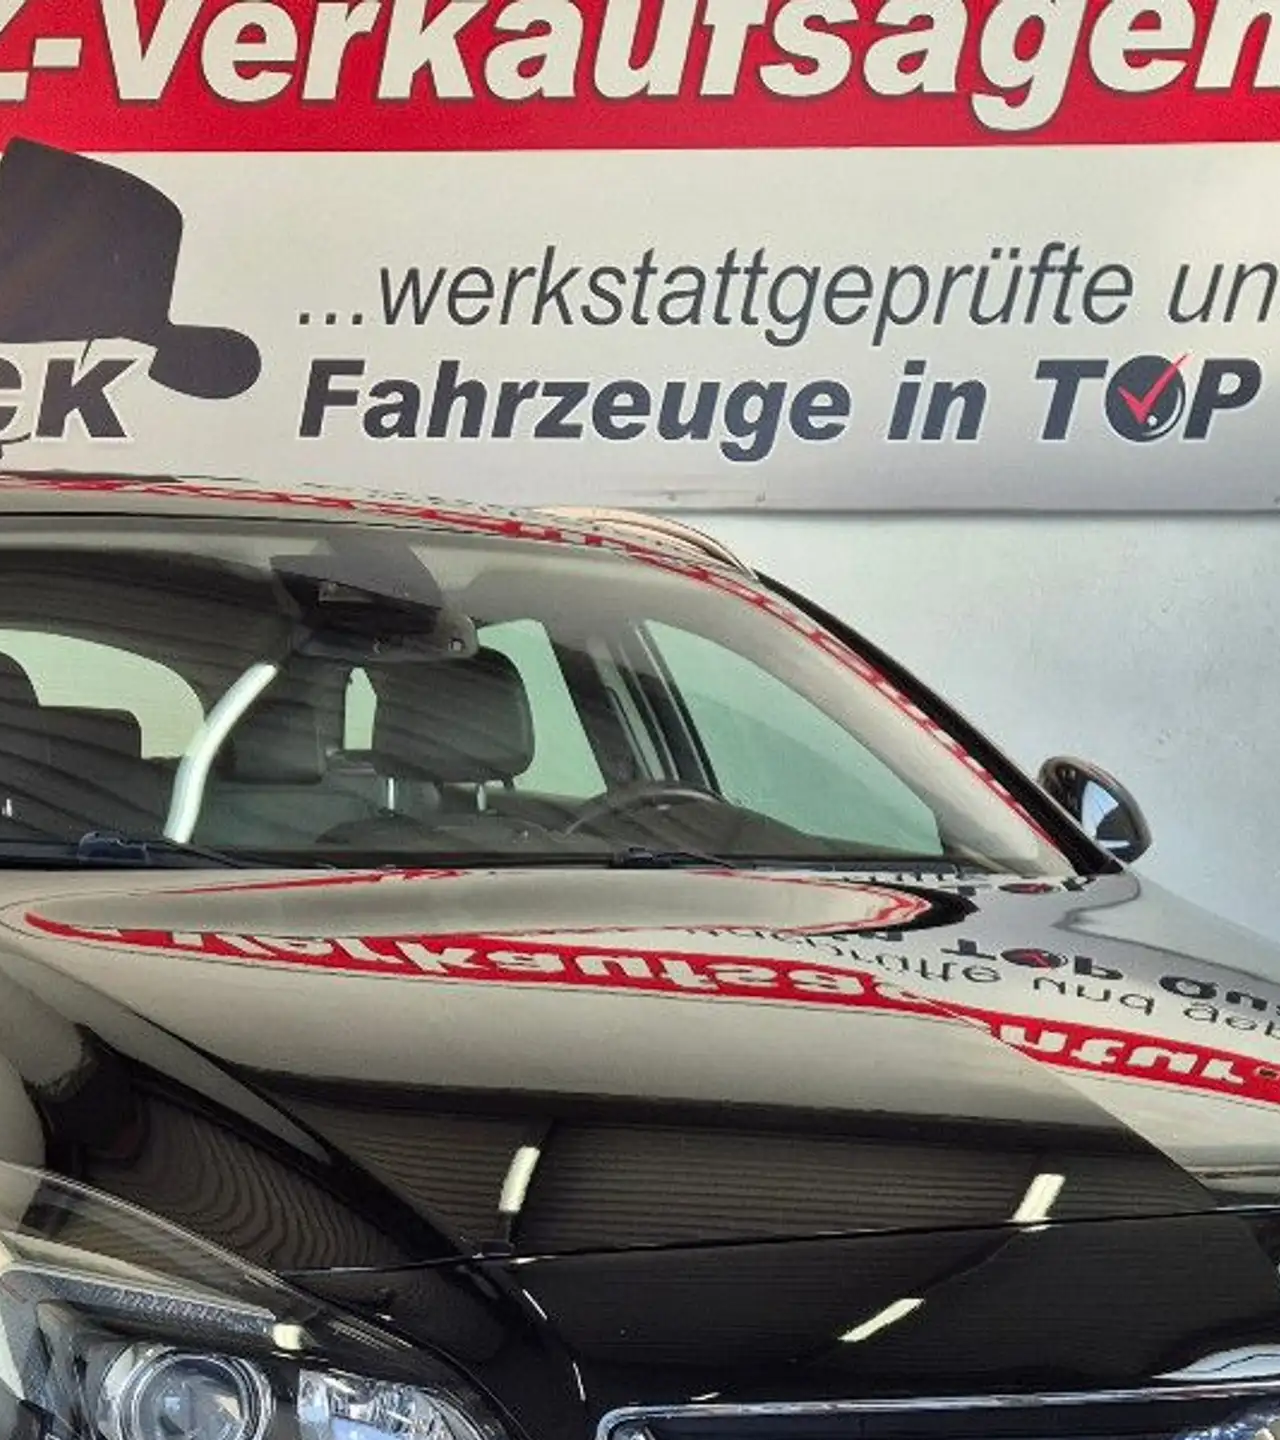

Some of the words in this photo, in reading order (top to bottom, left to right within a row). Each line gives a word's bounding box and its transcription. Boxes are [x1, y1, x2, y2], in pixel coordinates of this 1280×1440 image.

[298, 359, 852, 463] Fahrzeuge
[886, 360, 989, 443] in
[1034, 354, 1262, 444] TOP
